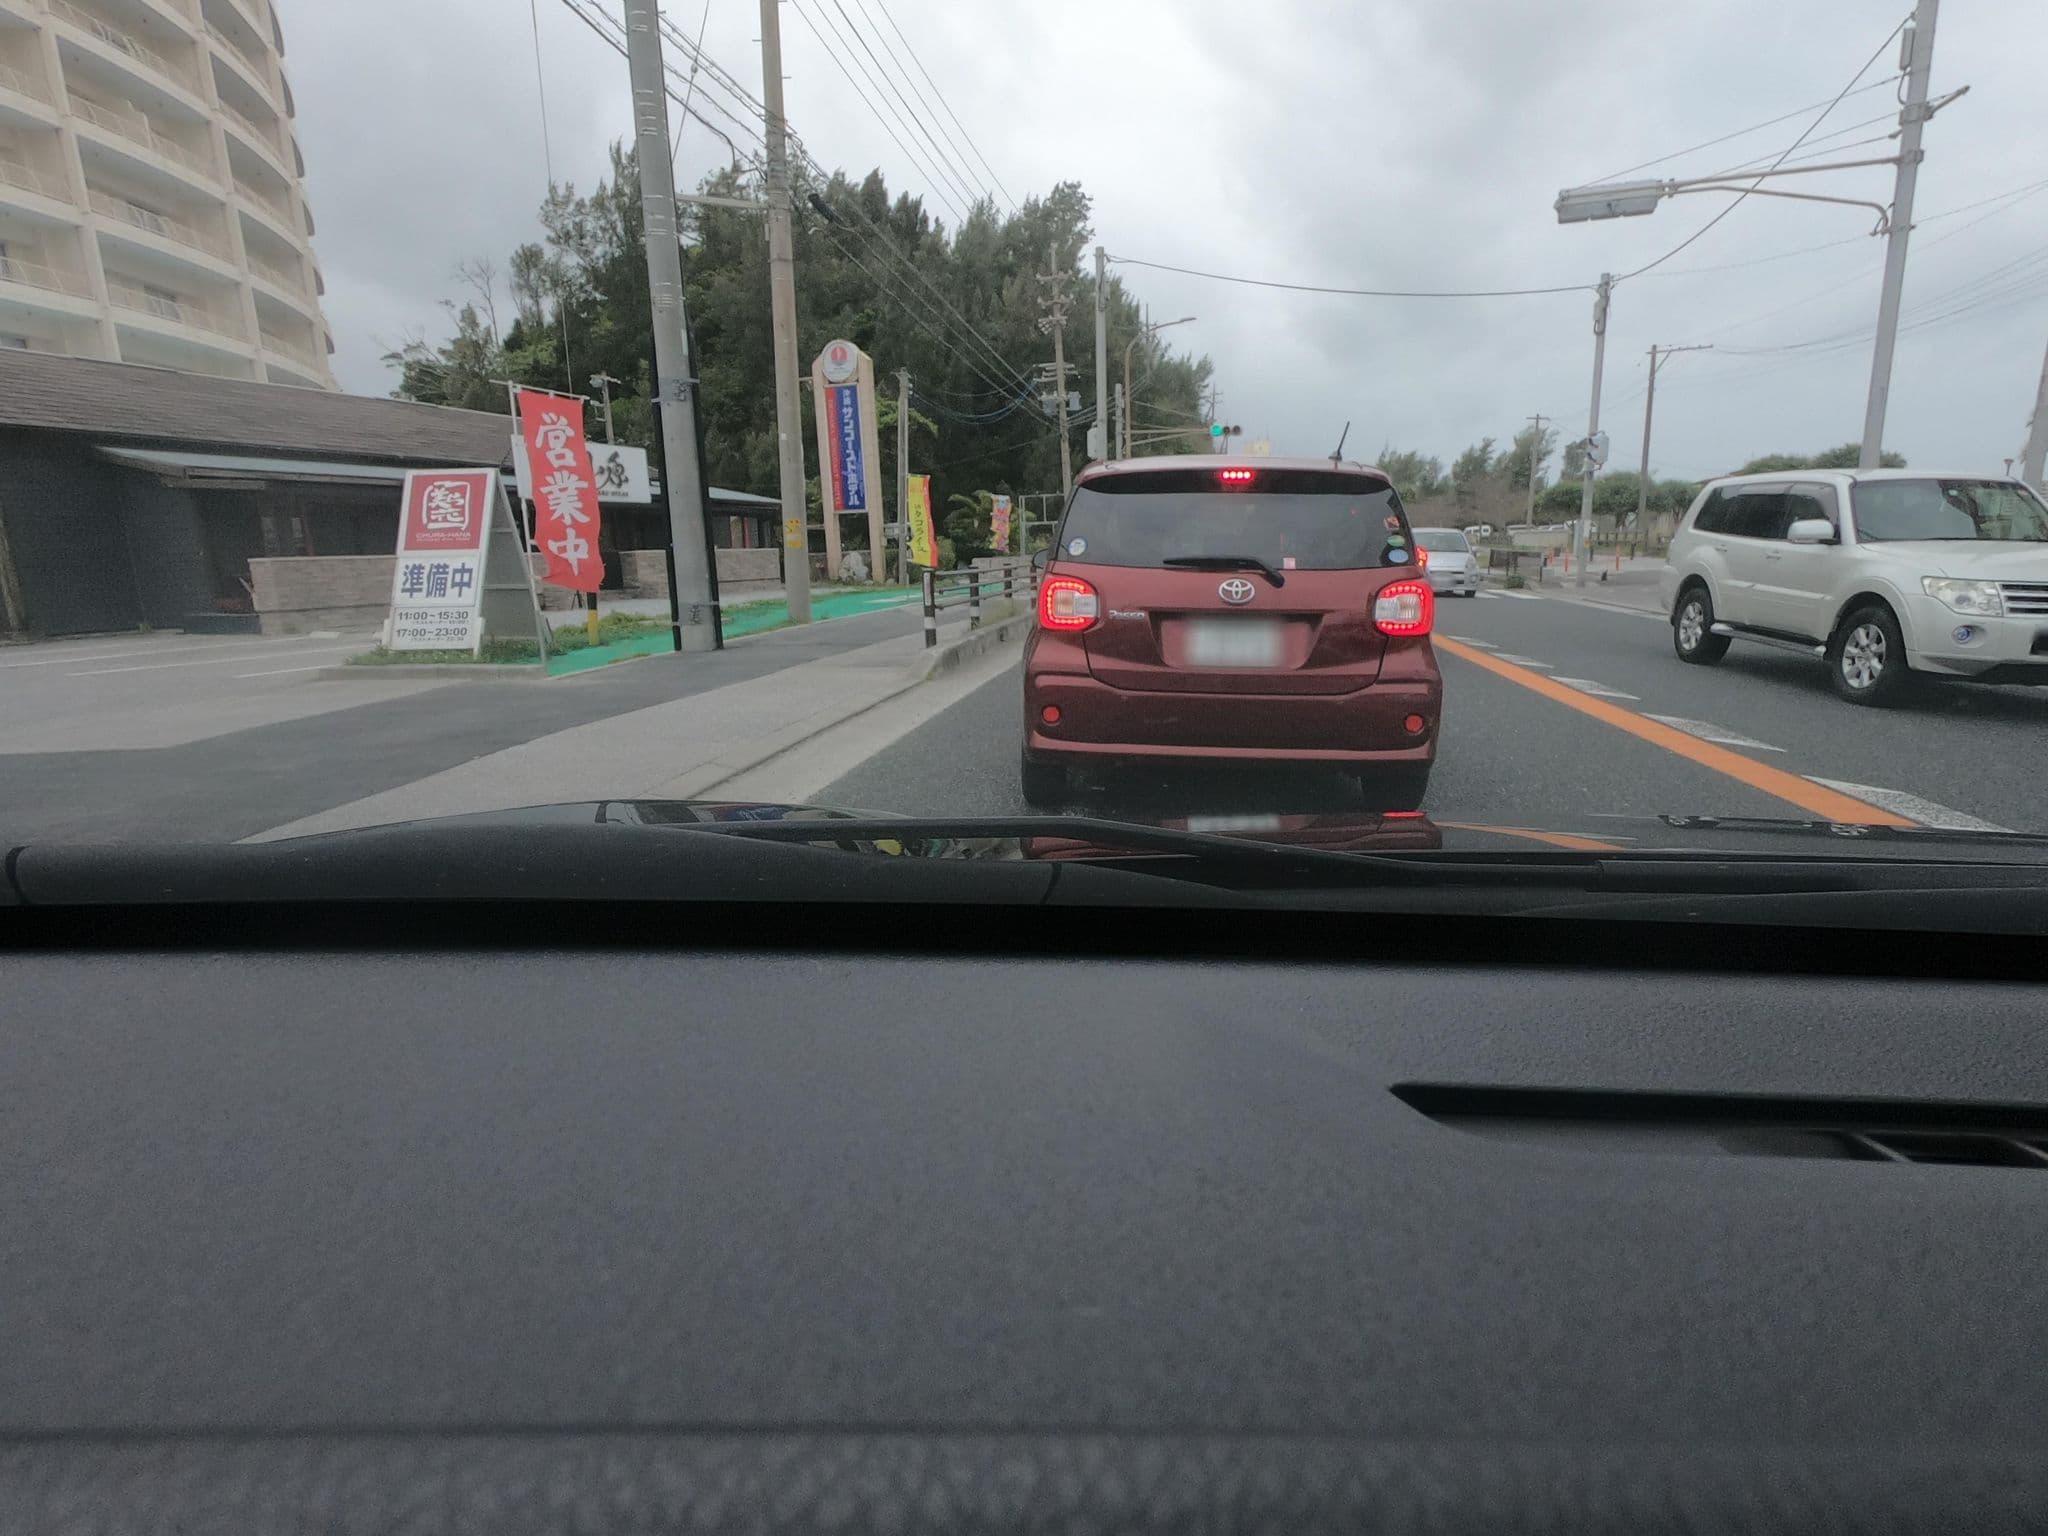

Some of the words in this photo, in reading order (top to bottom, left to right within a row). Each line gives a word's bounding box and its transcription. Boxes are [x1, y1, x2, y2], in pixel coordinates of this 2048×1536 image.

[535, 412, 591, 576] 営業中
[400, 562, 474, 599] 準備中
